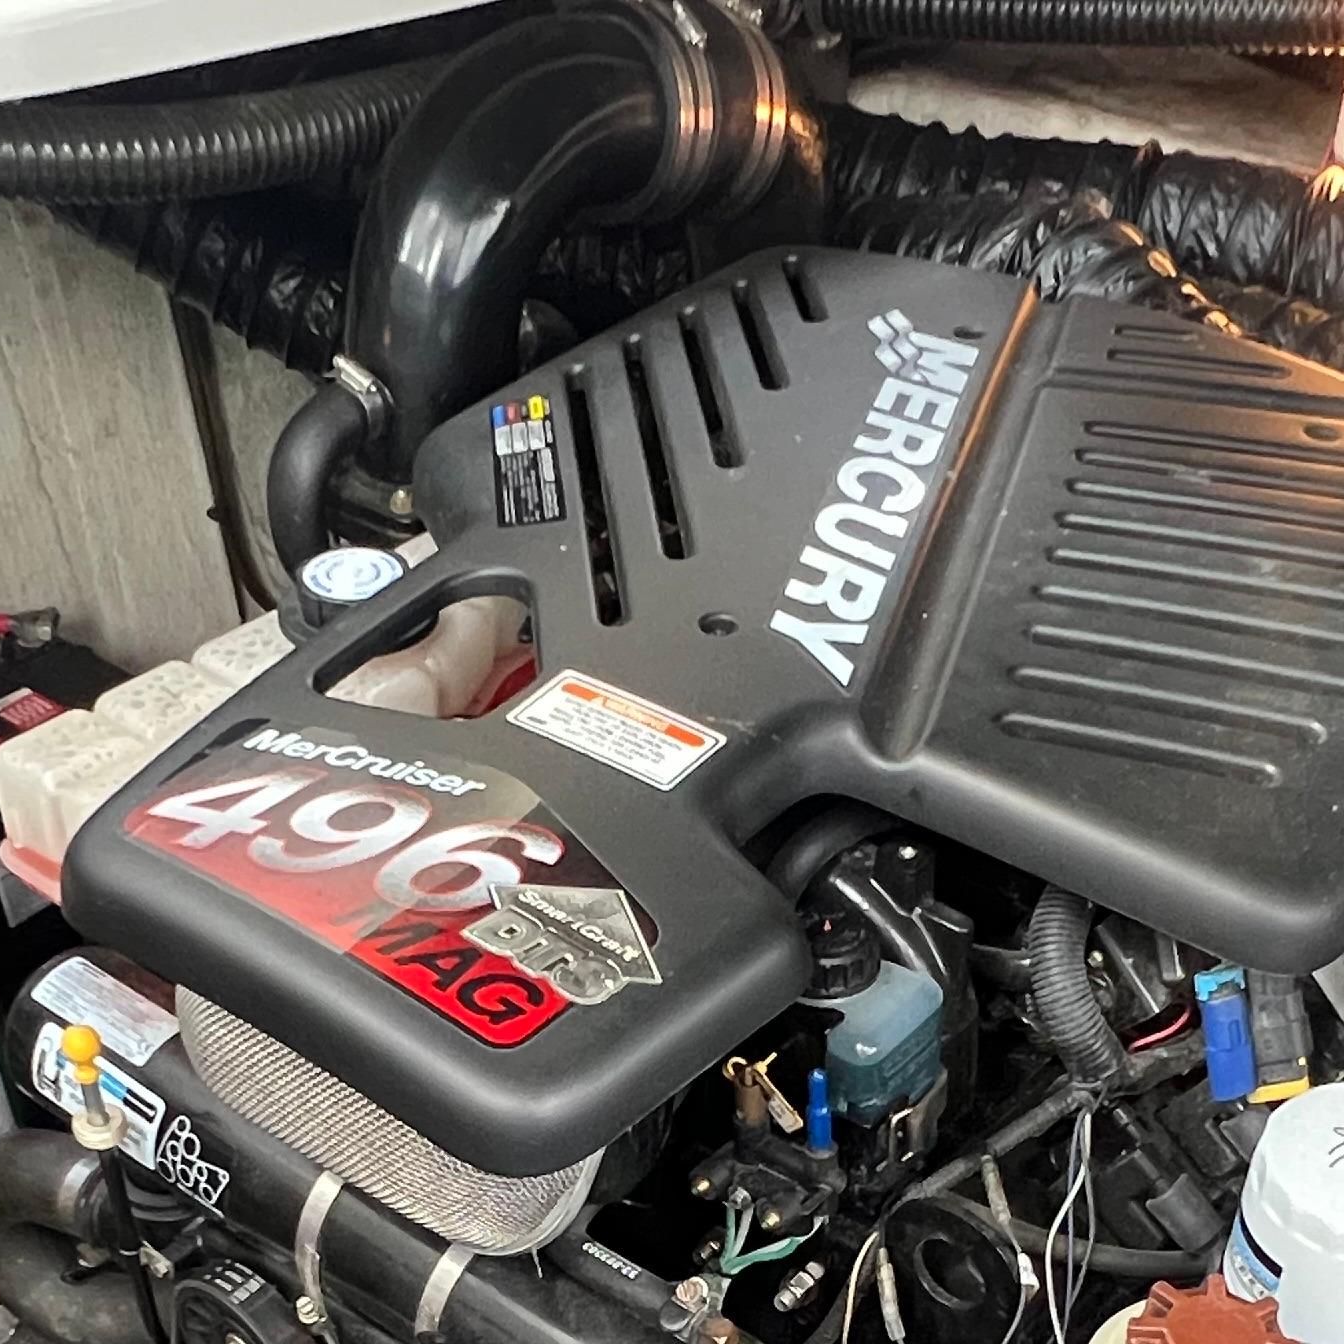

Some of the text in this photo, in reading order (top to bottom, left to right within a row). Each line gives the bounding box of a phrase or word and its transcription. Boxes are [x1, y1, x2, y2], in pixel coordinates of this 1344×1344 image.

[769, 329, 981, 688] MERCURY
[244, 728, 486, 797] MerCruiser
[147, 768, 564, 910] 496
[330, 902, 545, 1026] MAG
[517, 888, 643, 962] SmartCraft
